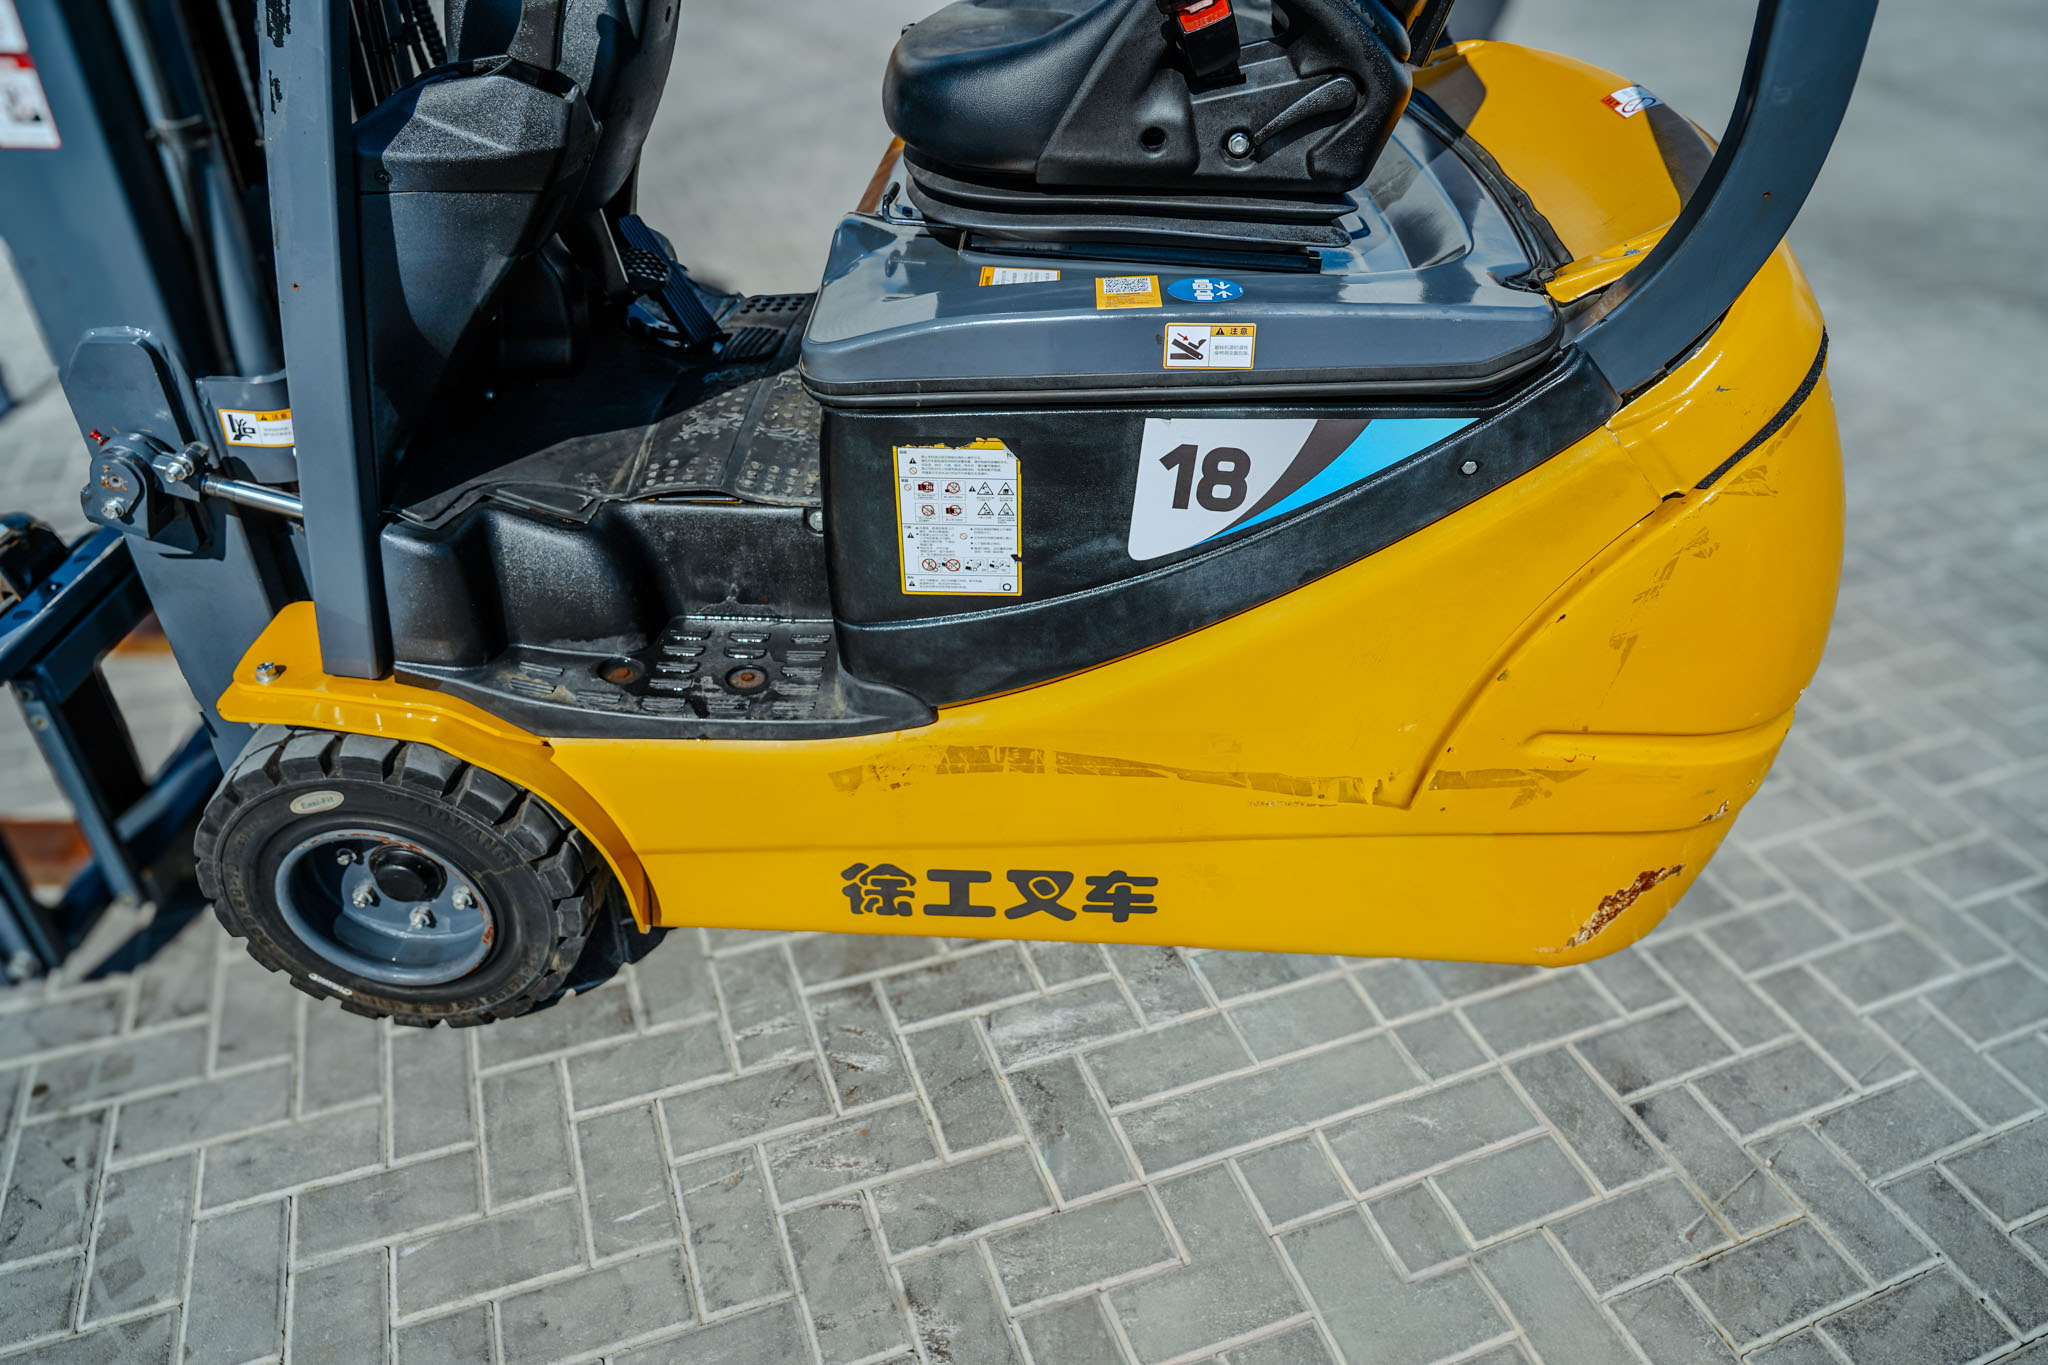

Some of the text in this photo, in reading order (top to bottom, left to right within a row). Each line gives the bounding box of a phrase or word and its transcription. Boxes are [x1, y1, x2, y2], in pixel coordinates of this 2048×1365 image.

[1230, 327, 1248, 336] 注意
[1159, 444, 1251, 512] 18
[841, 863, 1158, 923] 徐工叉车
